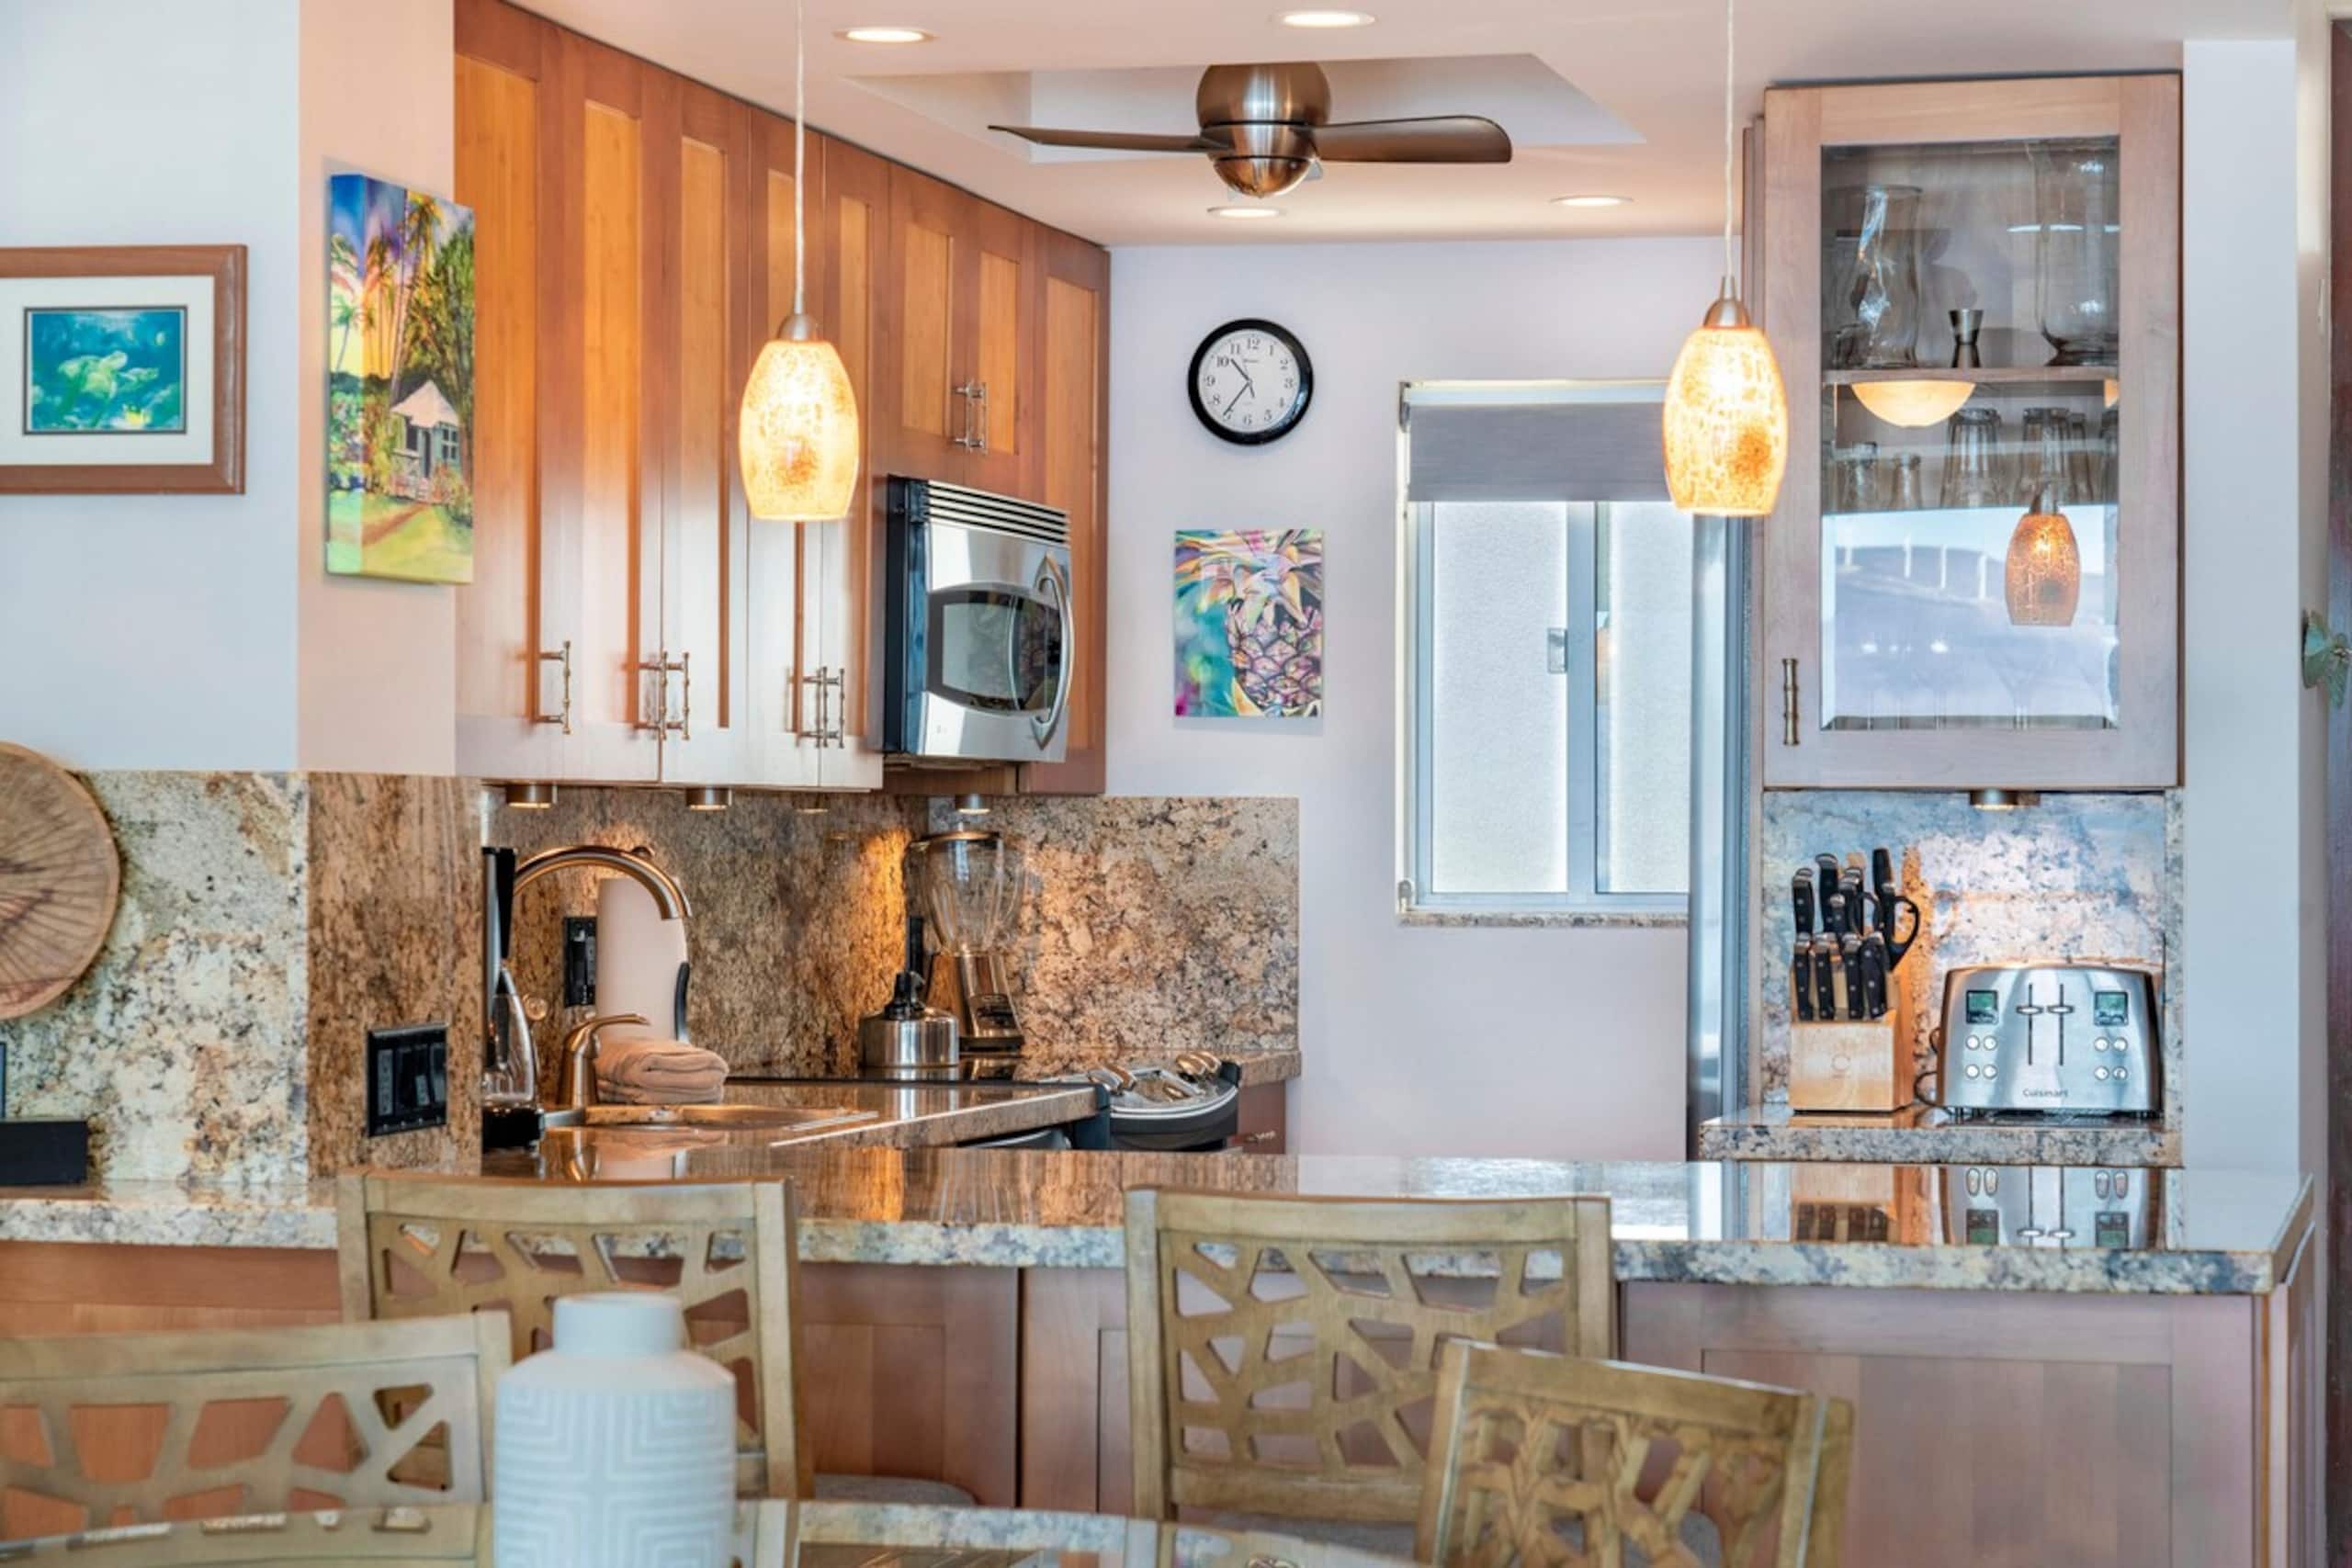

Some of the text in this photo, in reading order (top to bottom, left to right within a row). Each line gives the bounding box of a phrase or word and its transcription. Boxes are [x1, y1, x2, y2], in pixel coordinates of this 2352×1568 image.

[1230, 344, 1240, 355] 11
[1248, 338, 1261, 350] 12
[1216, 355, 1229, 367] 10
[2022, 1088, 2069, 1098] Cuisinart
